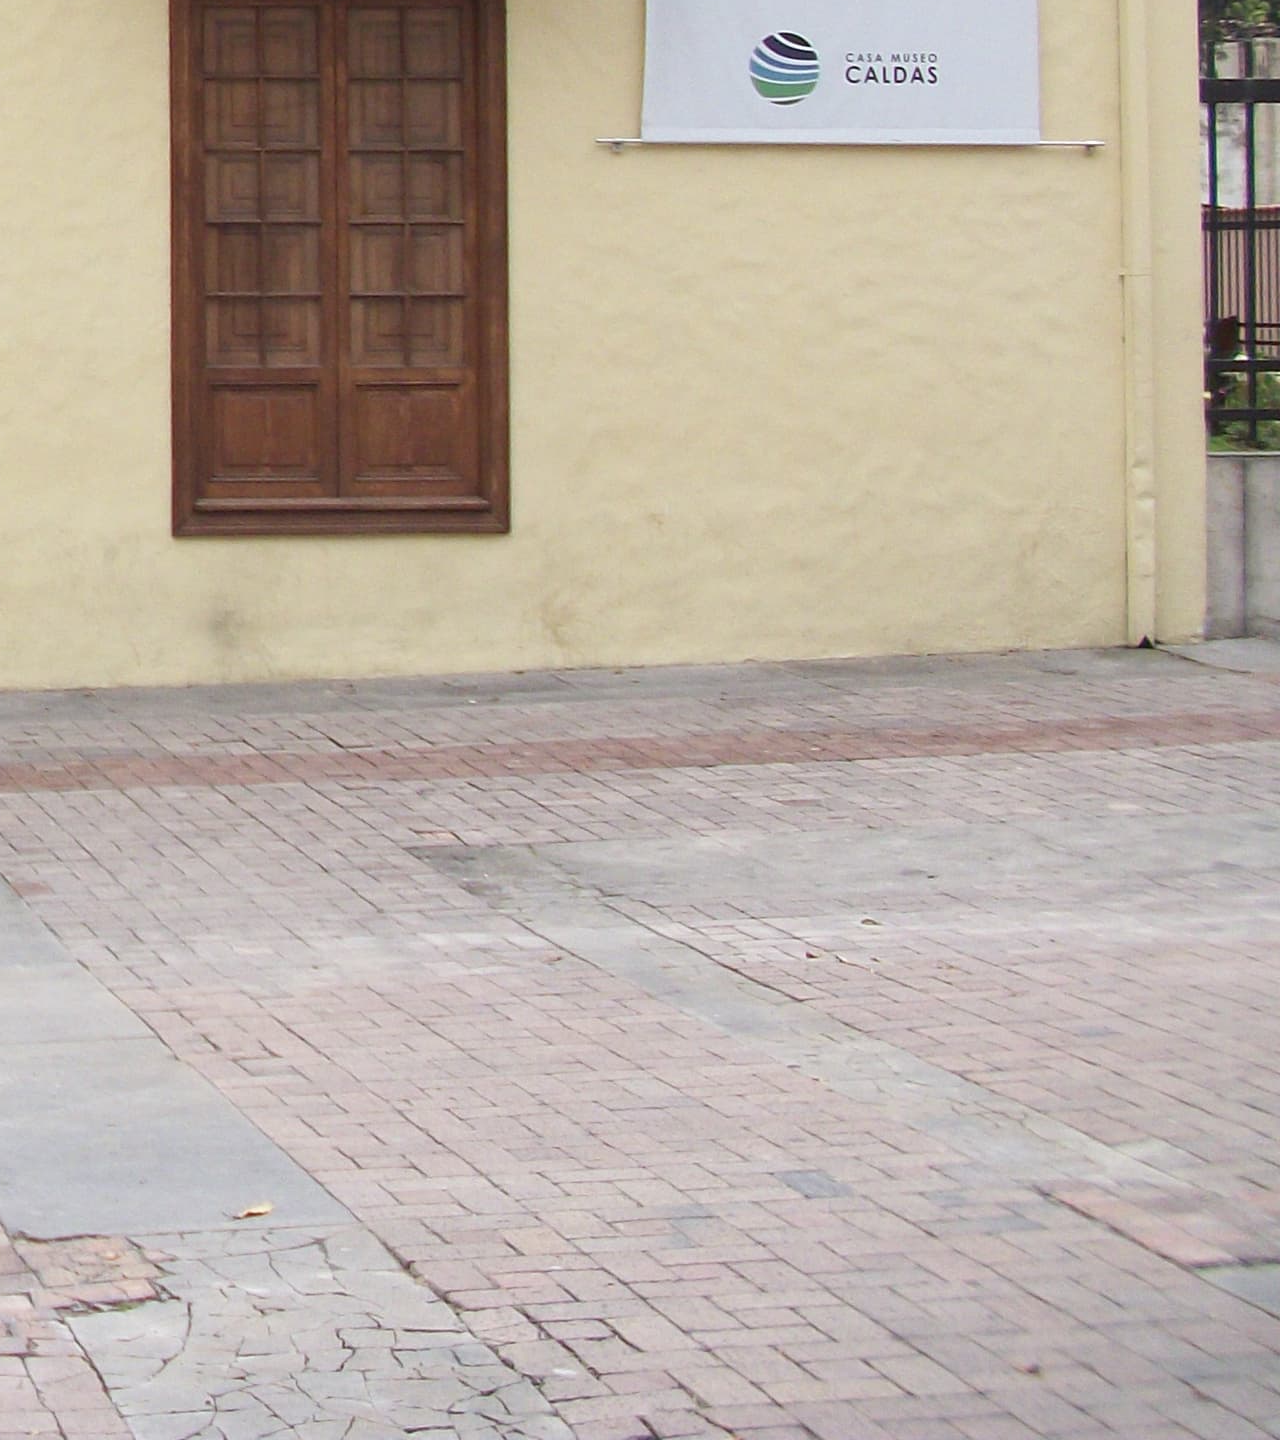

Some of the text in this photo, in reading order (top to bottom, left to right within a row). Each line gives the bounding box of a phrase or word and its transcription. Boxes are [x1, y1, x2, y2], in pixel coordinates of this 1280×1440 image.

[845, 53, 937, 63] CASA MUSEO
[845, 66, 938, 84] CALDAS
